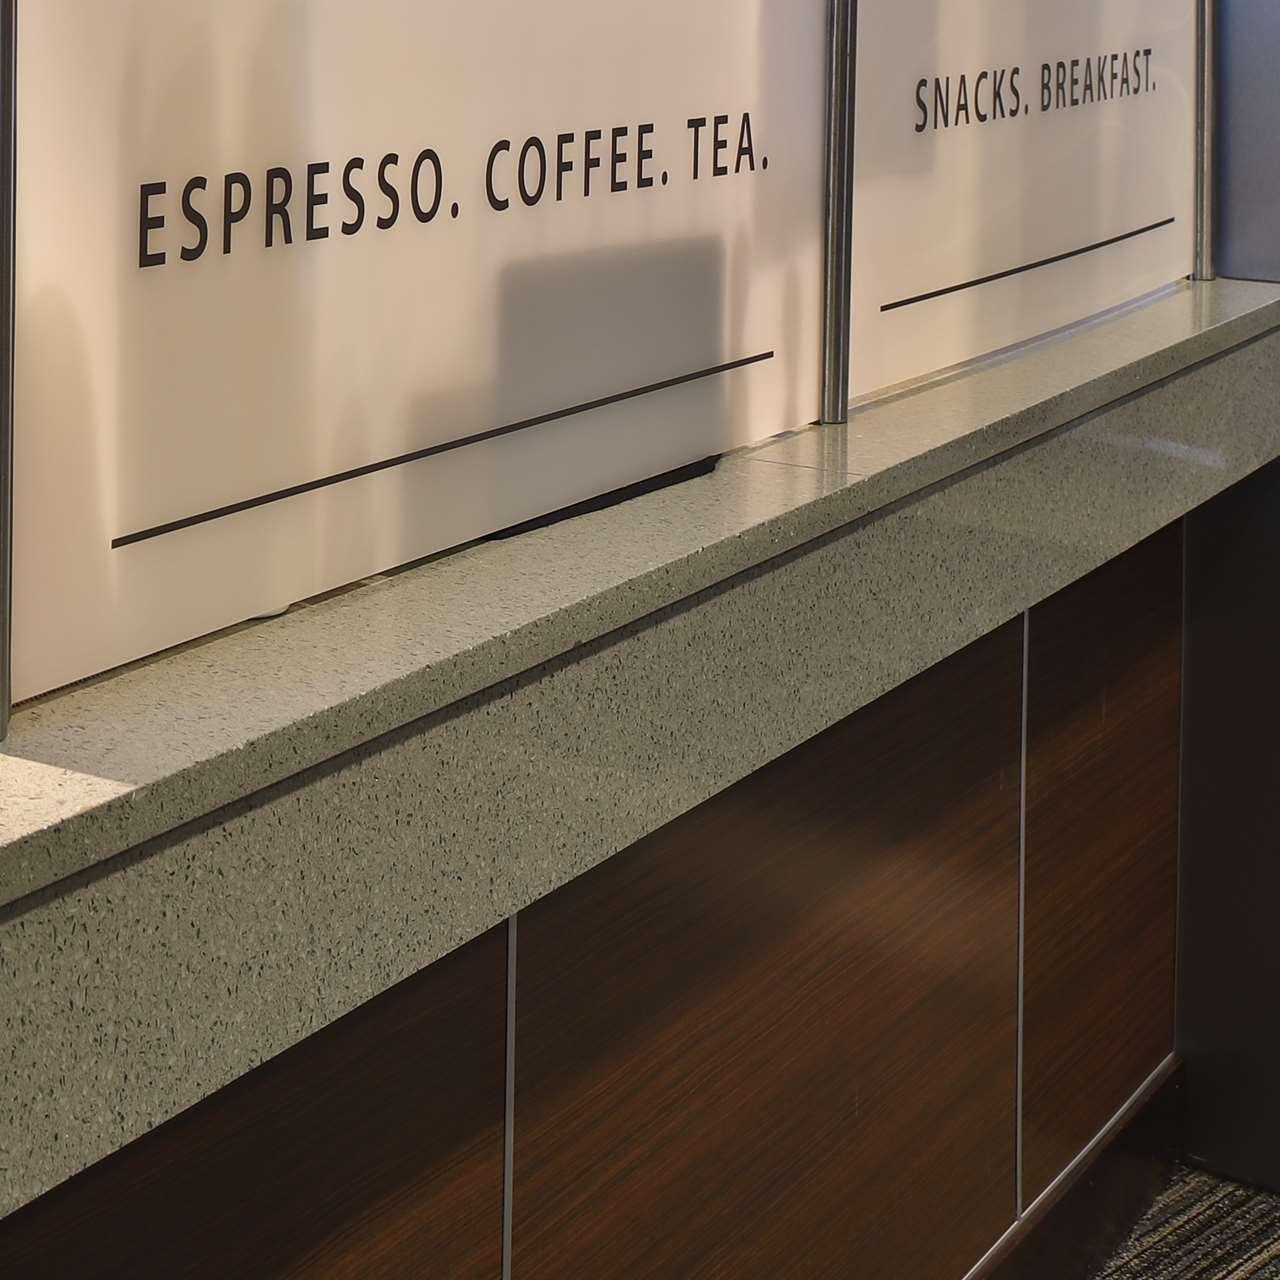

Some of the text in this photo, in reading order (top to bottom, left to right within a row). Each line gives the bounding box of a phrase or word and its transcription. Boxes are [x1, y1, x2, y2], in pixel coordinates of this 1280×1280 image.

[914, 48, 1156, 132] SNACKS. BREAKFAST.
[139, 111, 769, 268] ESPRESSO. COFFEE. TEA.
